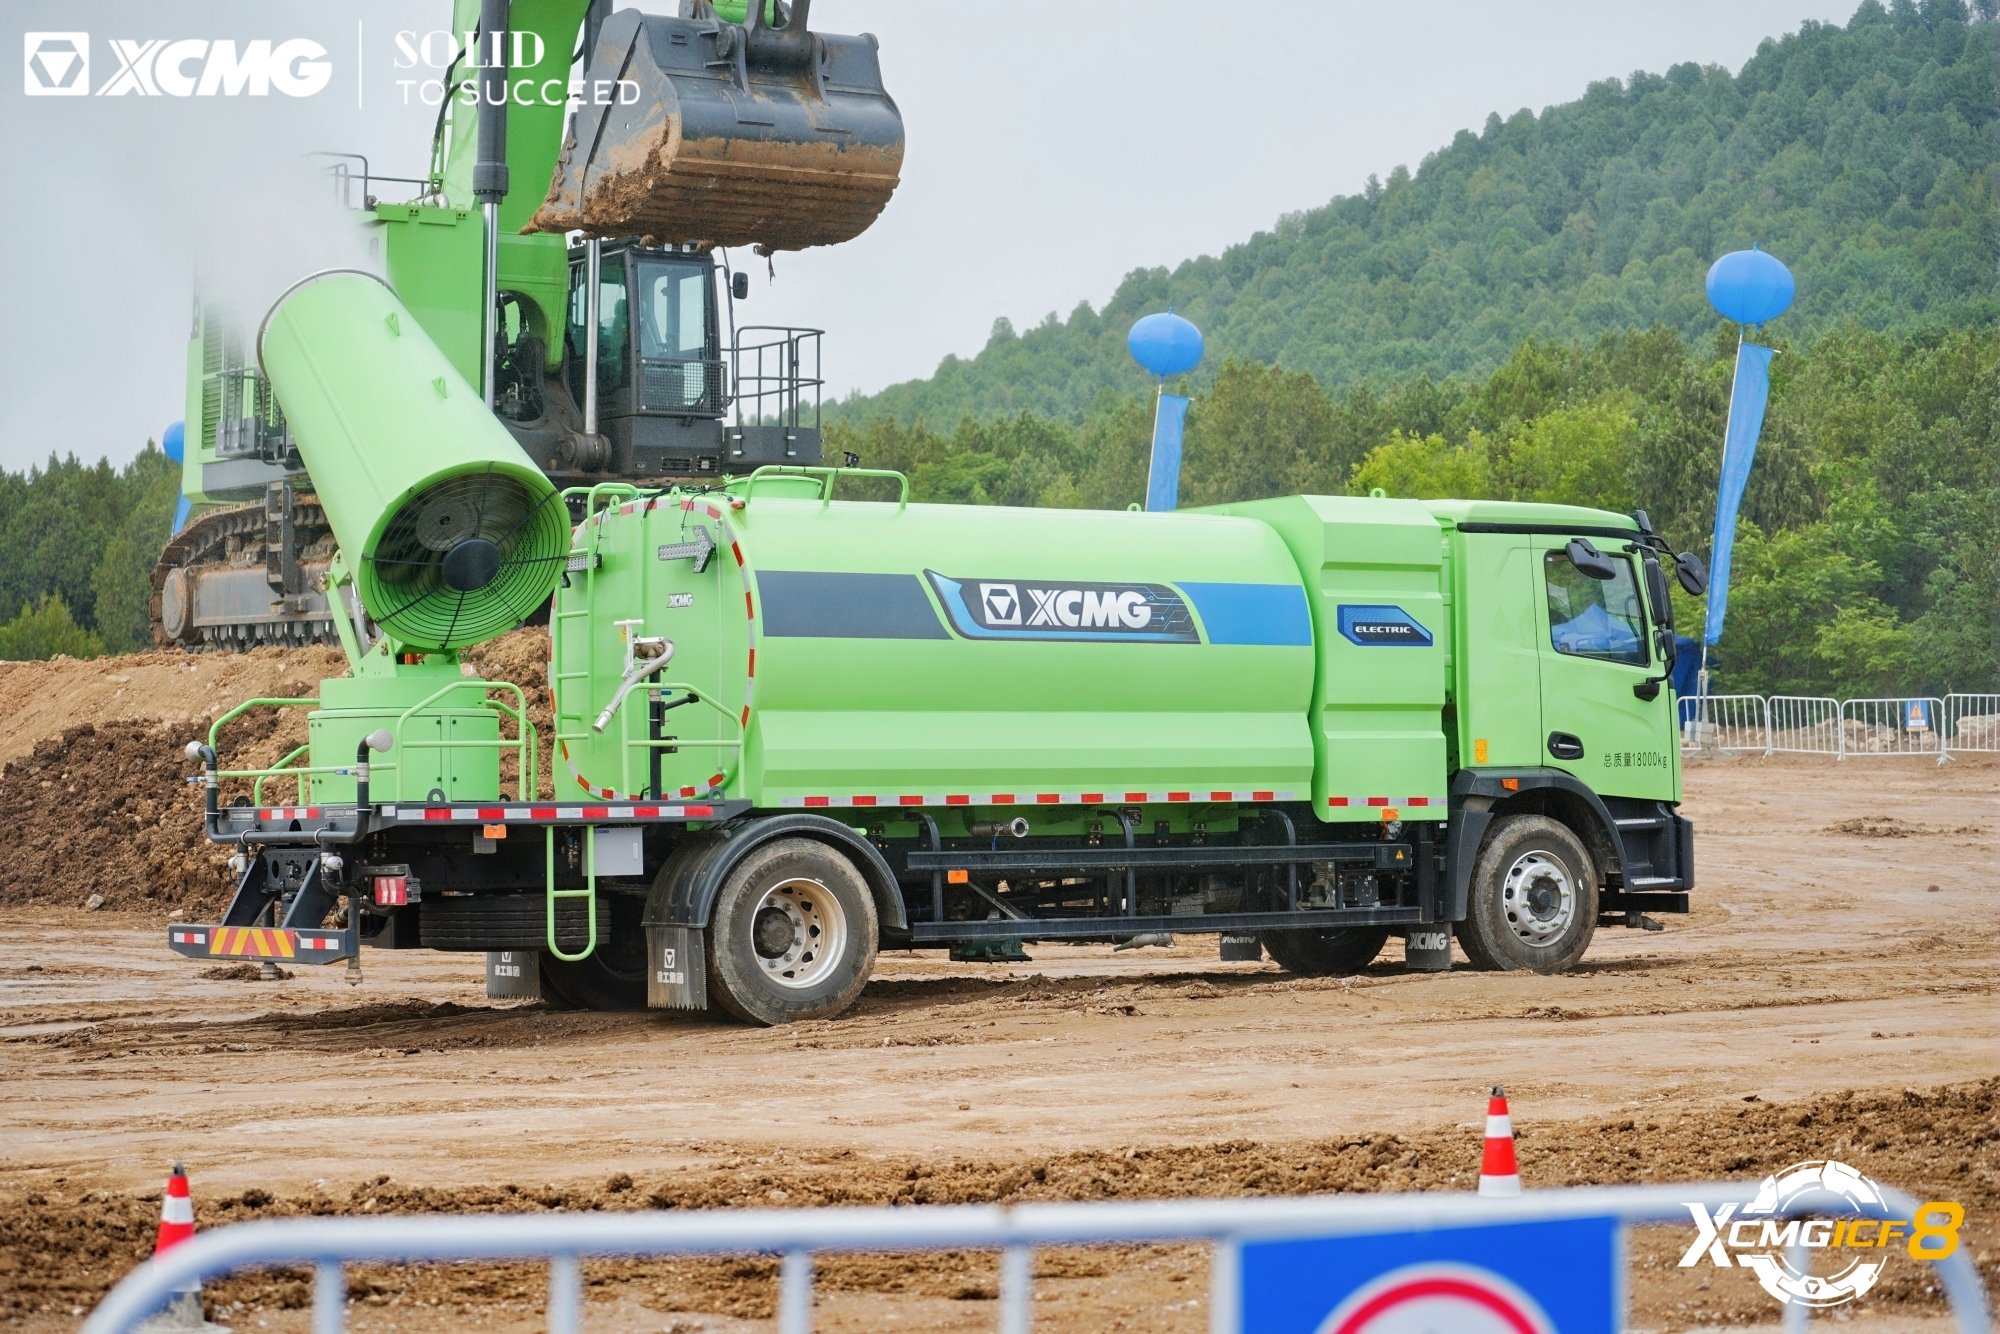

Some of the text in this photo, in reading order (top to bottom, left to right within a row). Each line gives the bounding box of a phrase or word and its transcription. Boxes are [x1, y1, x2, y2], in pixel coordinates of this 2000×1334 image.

[667, 593, 693, 608] XCMG
[1025, 589, 1152, 628] XCMG
[1355, 626, 1411, 634] ELECTRIC
[1603, 752, 1667, 768] 总质量18000kg
[1407, 932, 1447, 951] XCMG
